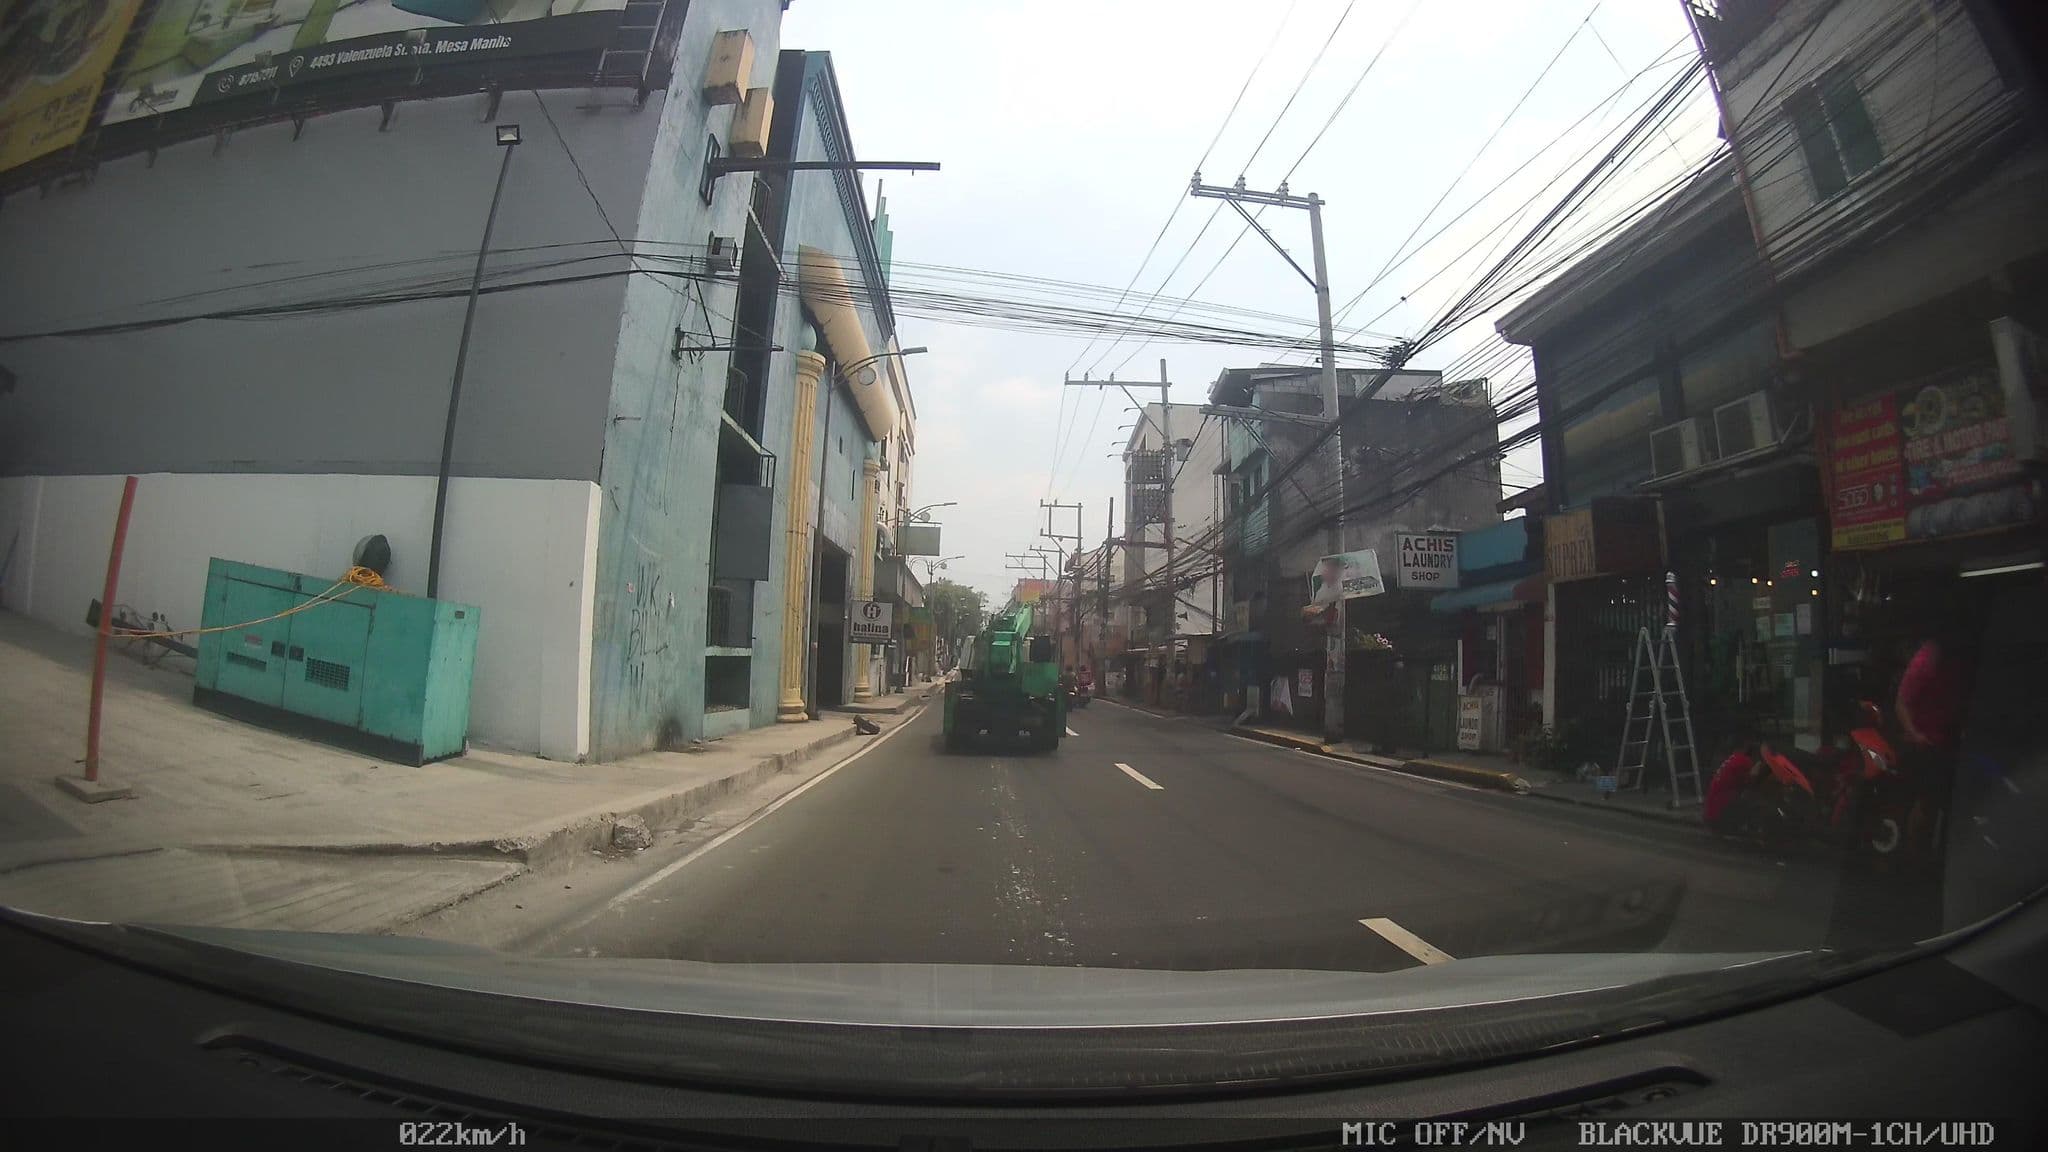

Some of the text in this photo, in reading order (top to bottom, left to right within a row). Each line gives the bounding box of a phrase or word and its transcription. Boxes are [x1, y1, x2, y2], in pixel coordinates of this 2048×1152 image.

[310, 53, 334, 69] 4493
[336, 44, 393, 64] Valenzuela
[394, 43, 408, 56] St.
[435, 40, 467, 54] Mesa
[470, 35, 512, 51] Manila
[1402, 537, 1454, 552] ACHIS
[1402, 553, 1454, 568] LAUNDRY
[1411, 571, 1440, 581] SHOP
